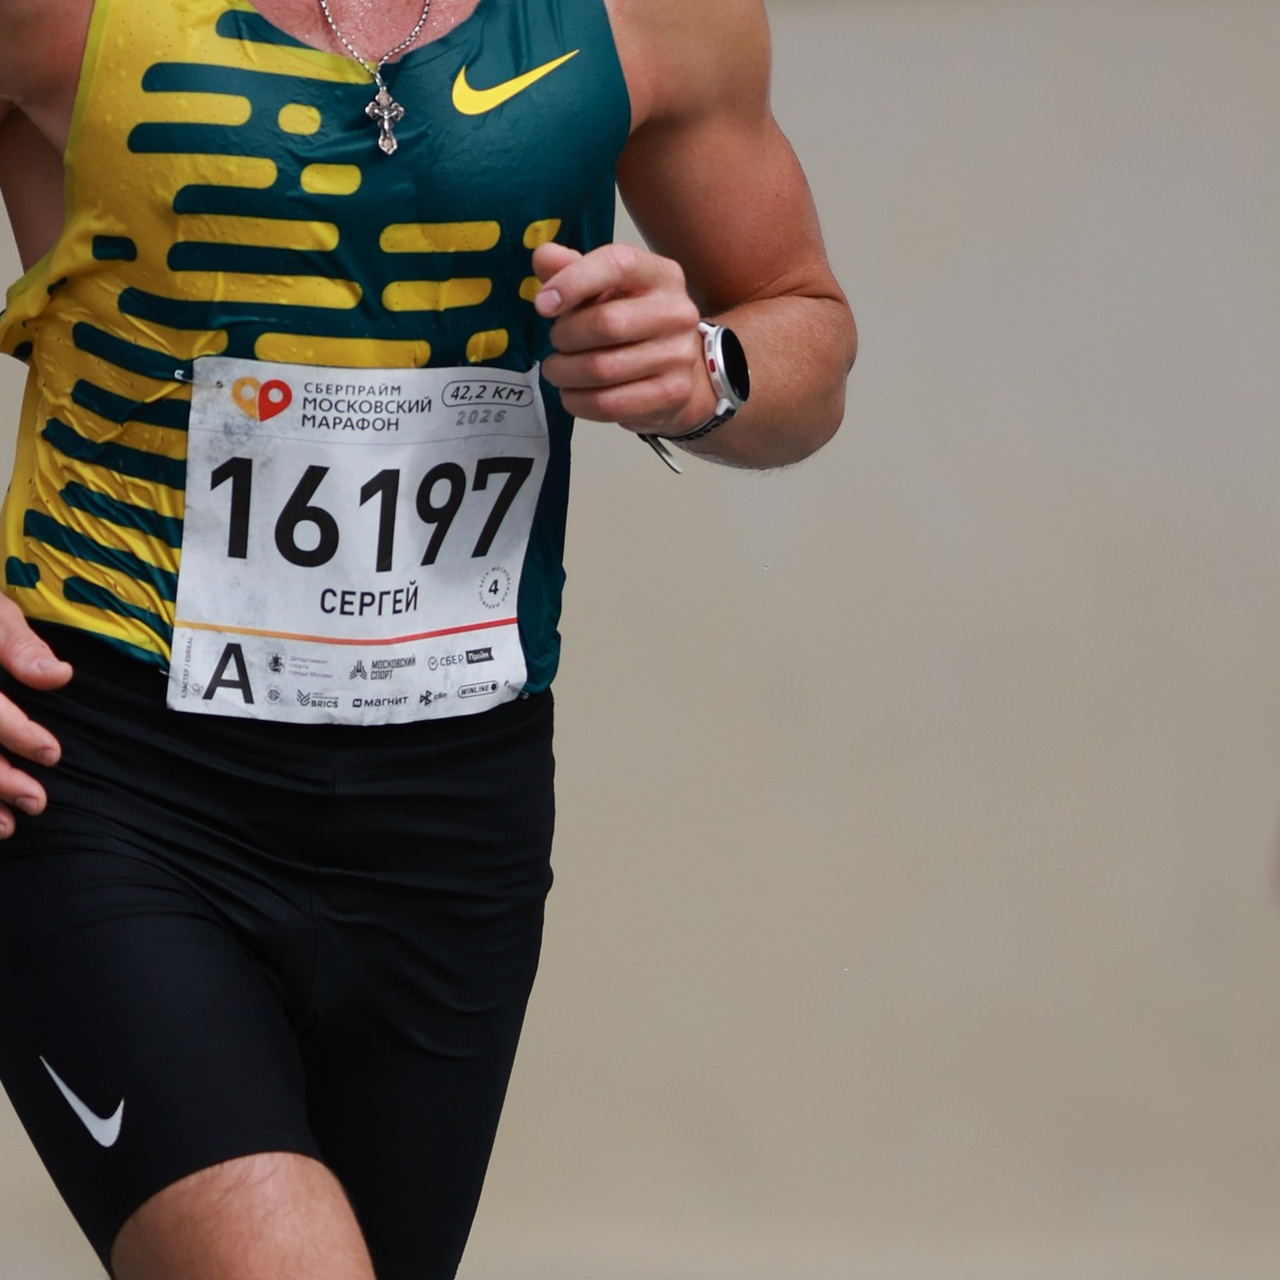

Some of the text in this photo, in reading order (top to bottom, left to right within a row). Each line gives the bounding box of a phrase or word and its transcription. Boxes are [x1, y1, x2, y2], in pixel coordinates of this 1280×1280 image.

[303, 381, 401, 396] СБЕРПРАЙМ
[450, 384, 524, 402] 42,2 КМ
[302, 396, 432, 414] МОСКОВСКИЙ
[301, 413, 400, 432] МАРАФОН
[455, 409, 507, 426] 2026
[210, 456, 535, 573] 16197
[488, 579, 499, 595] 4
[320, 580, 419, 616] СЕРГЕЙ
[371, 654, 416, 670] МОСКОВСКИЙ
[440, 654, 464, 667] СБЕР
[370, 669, 393, 680] СПОРТ
[461, 684, 490, 696] WINLINE
[311, 700, 339, 708] BRICS
